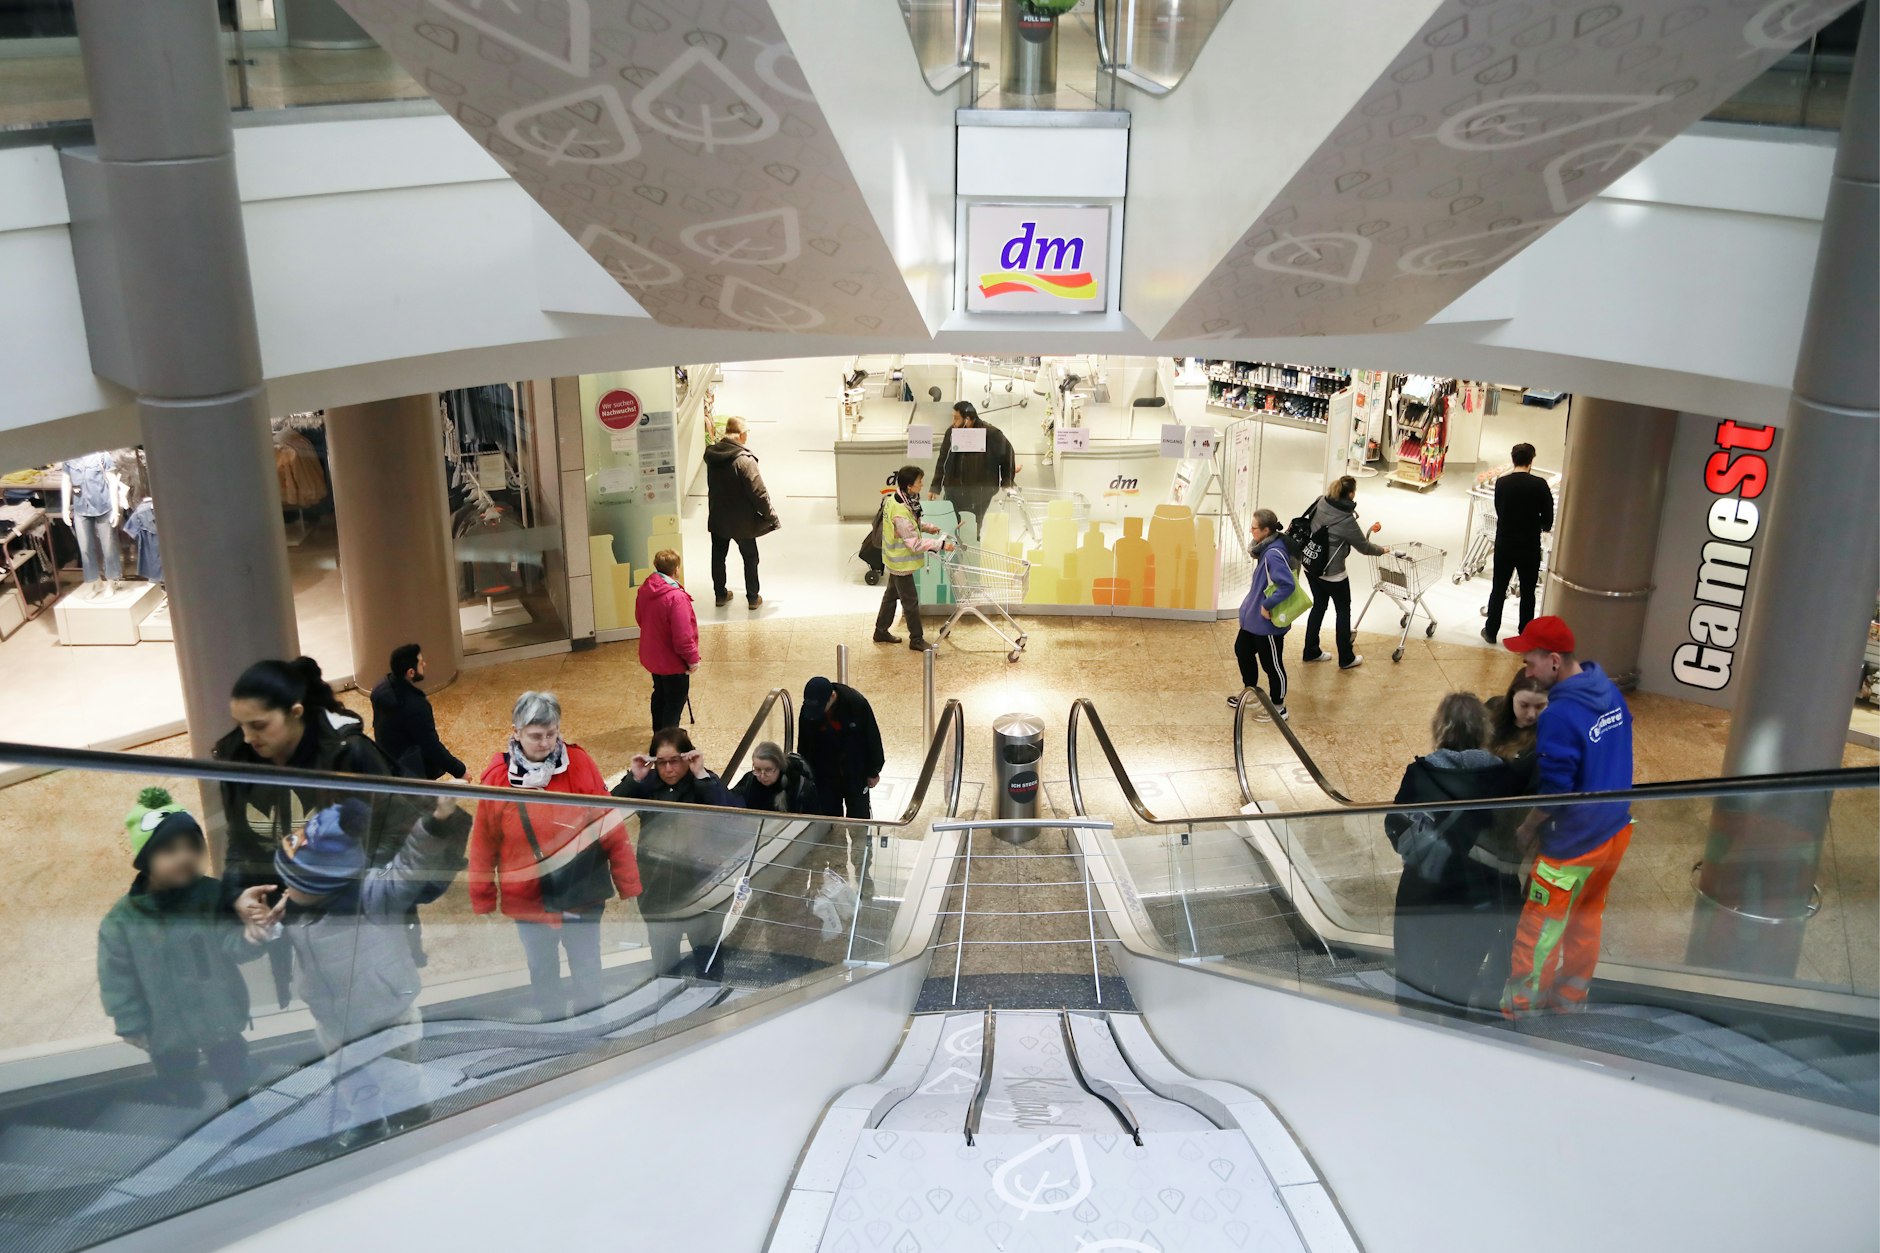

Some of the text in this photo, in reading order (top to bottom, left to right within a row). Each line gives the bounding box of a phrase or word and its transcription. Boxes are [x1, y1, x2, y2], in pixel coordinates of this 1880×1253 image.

[1000, 221, 1085, 271] dm
[613, 399, 635, 408] suchen
[601, 405, 637, 417] Nachwuchs!
[1109, 474, 1139, 490] dm
